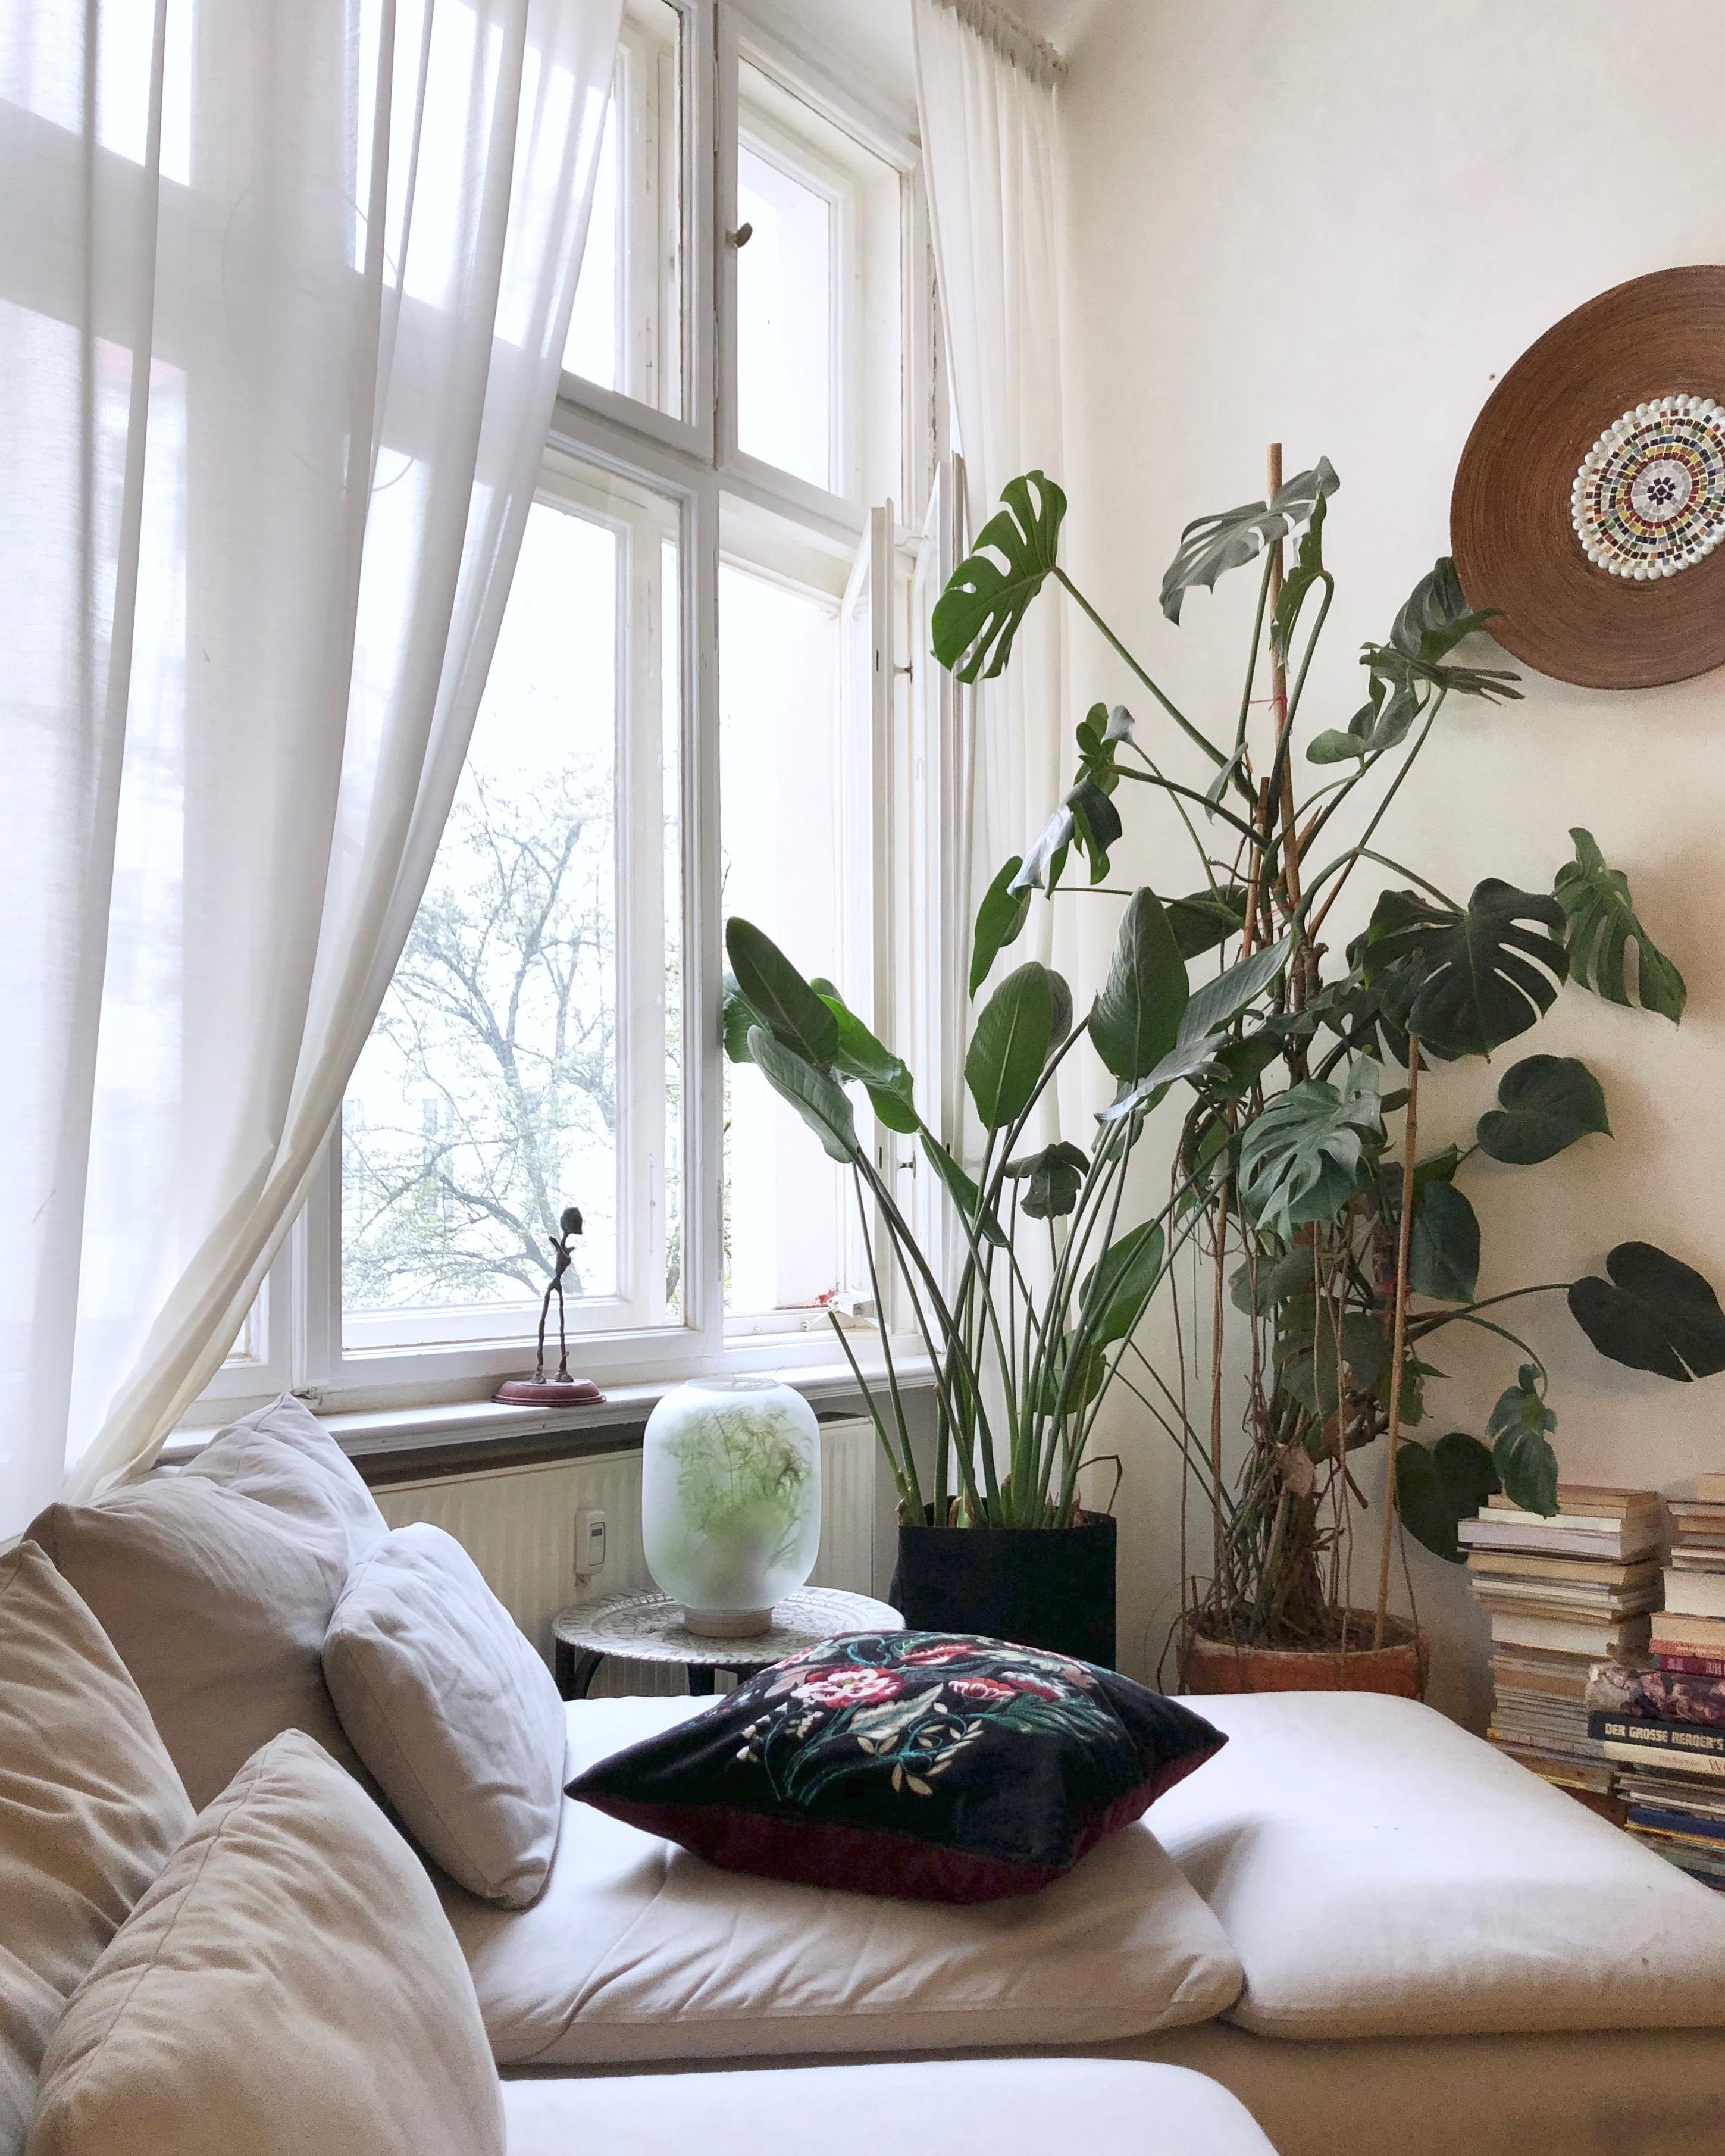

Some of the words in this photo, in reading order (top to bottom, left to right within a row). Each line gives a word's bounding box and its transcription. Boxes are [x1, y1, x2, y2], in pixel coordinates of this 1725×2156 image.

[1604, 1723, 1626, 1737] DER
[1629, 1726, 1668, 1742] GROSSE
[1671, 1731, 1724, 1751] READER'S
